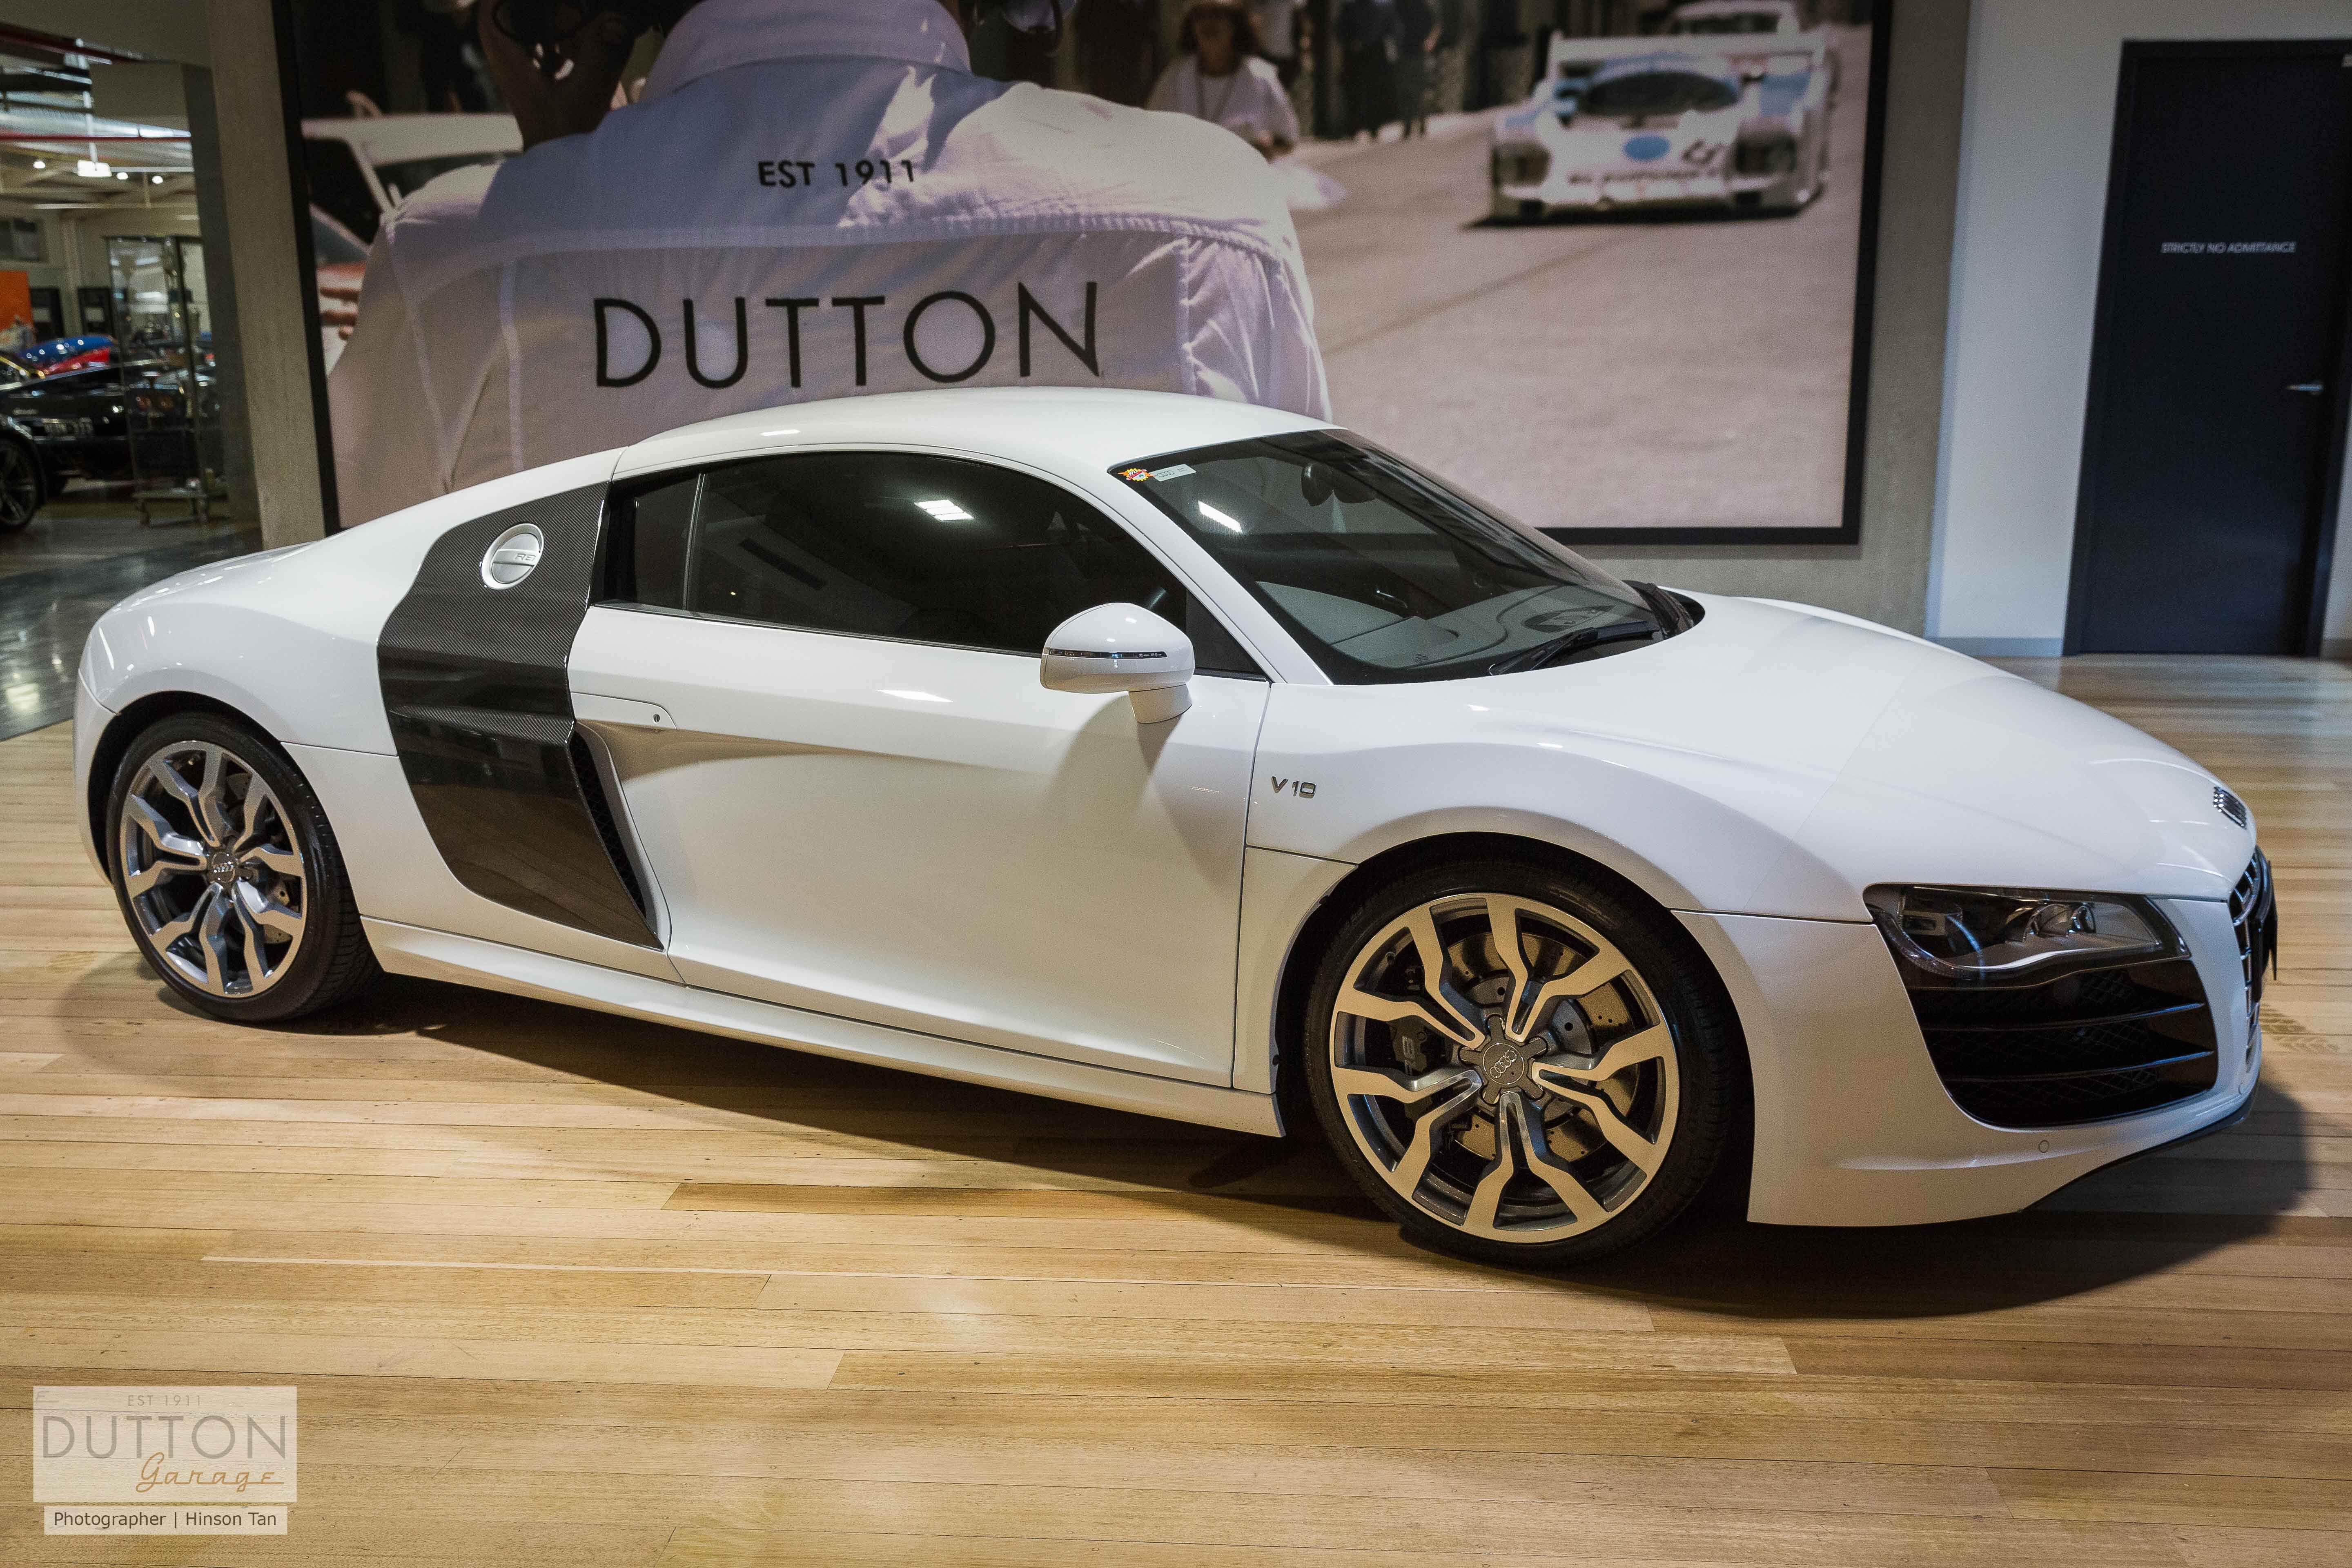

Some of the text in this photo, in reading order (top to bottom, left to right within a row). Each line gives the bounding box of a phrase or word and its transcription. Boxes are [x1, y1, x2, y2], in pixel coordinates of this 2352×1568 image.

[758, 159, 914, 188] EST 1911
[2207, 242, 2227, 254] NO
[593, 281, 1100, 389] DUTTON
